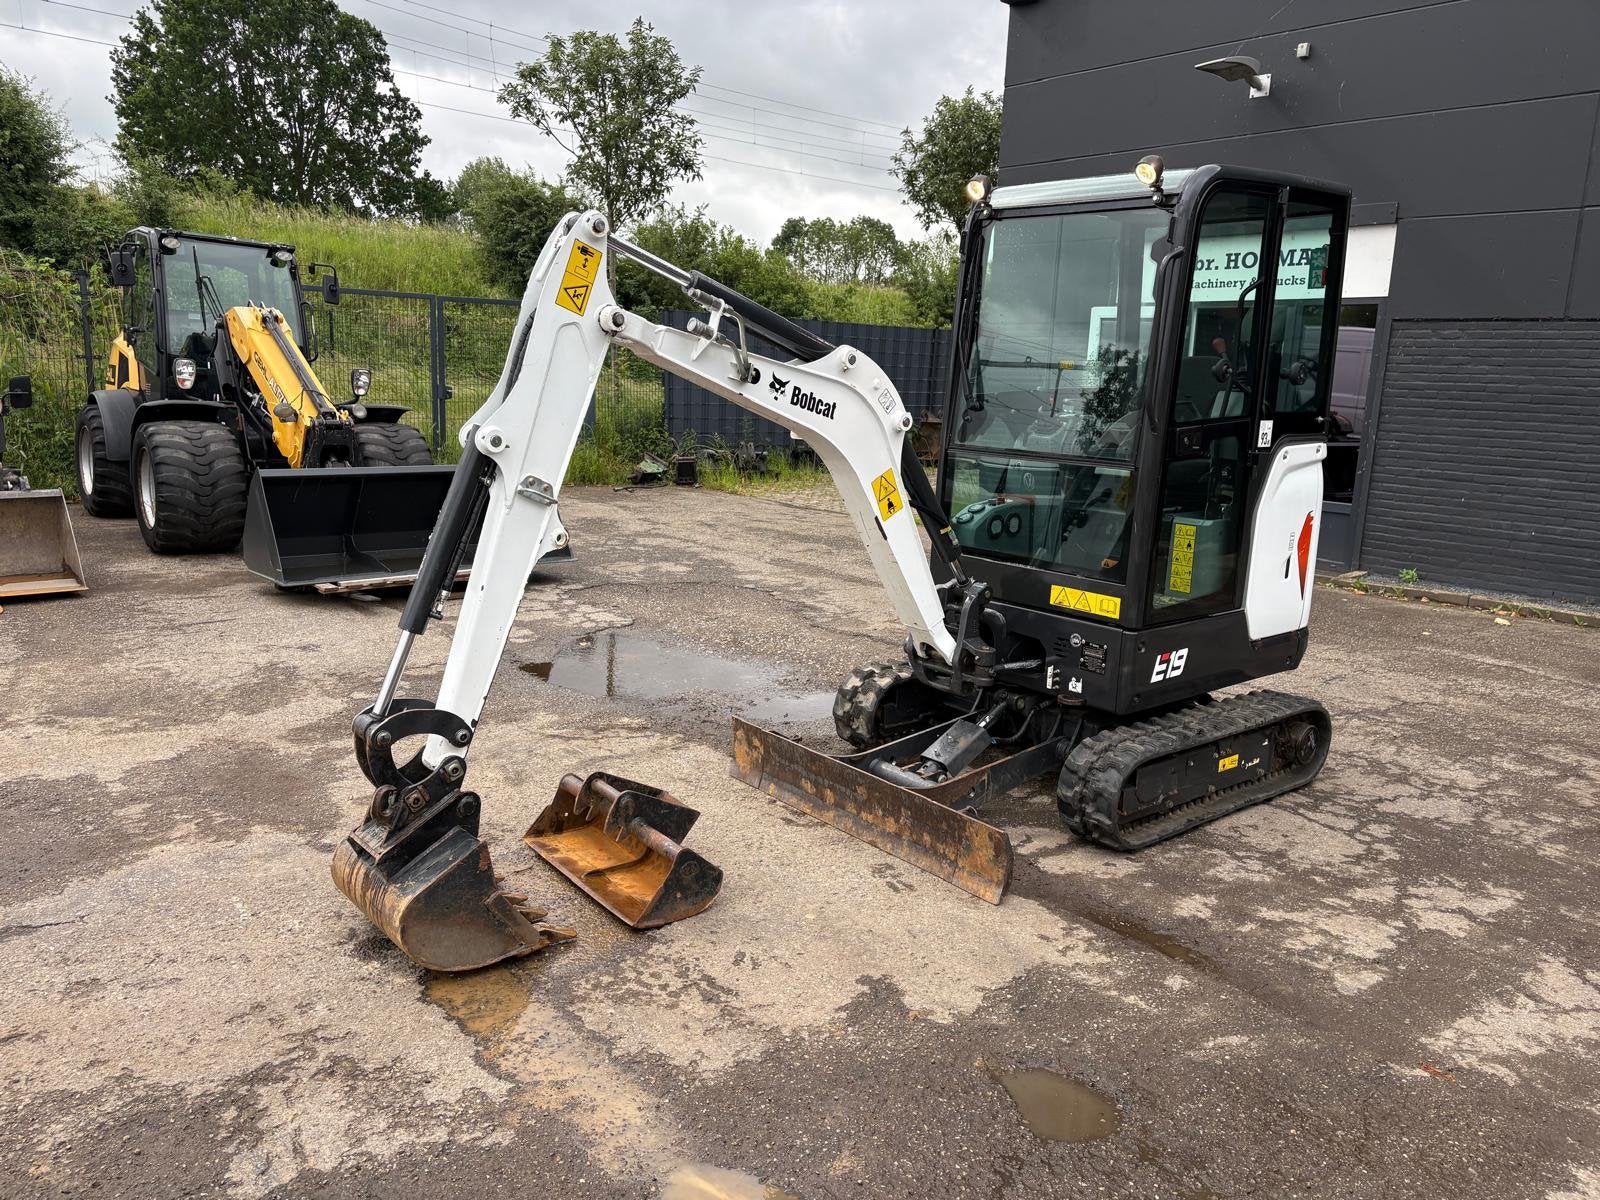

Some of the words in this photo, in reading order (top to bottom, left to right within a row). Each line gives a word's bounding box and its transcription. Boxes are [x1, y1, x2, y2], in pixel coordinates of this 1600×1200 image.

[1224, 248, 1312, 269] HOMA
[1192, 278, 1247, 290] achinery
[1277, 276, 1306, 286] ucks
[790, 385, 837, 420] Bobcat
[1150, 647, 1189, 684] E19
